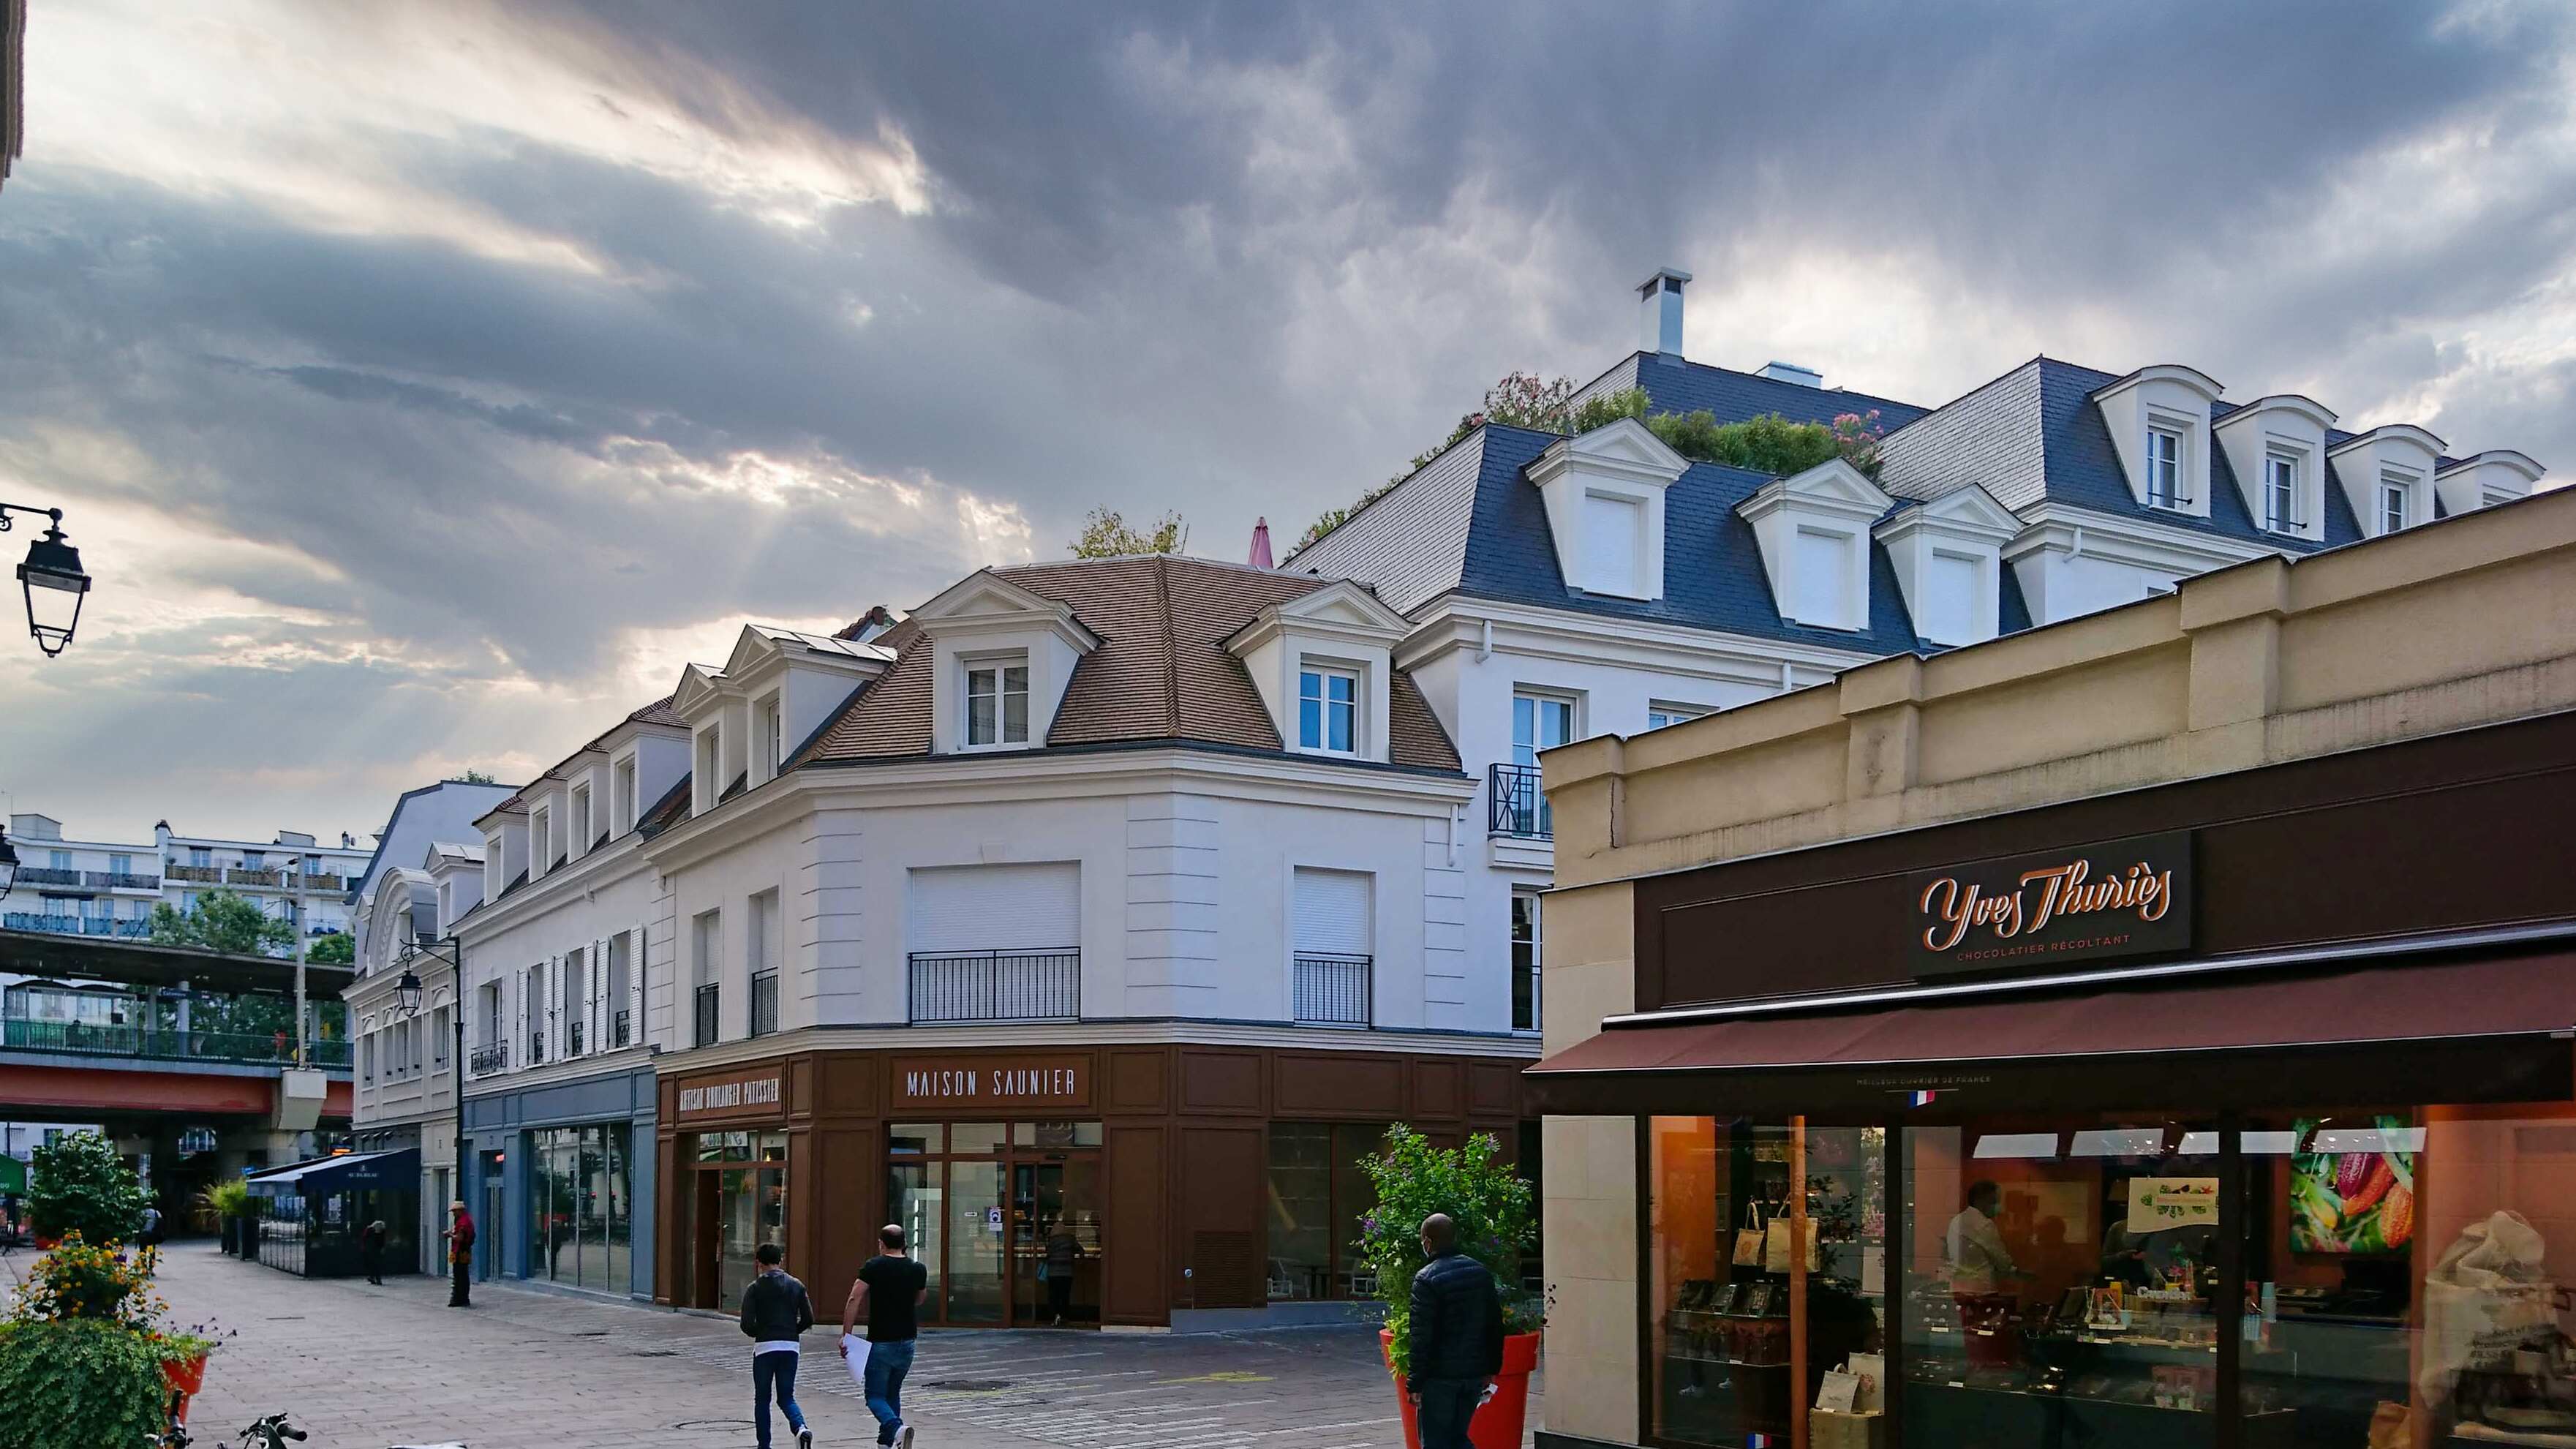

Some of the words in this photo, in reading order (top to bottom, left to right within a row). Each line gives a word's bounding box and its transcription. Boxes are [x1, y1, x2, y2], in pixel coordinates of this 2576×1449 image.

[1919, 877, 2022, 952] Yves
[2019, 858, 2172, 935] Thuriès
[1957, 944, 2046, 961] CHOCOLATIER
[907, 1070, 976, 1096] MAISON
[993, 1069, 1074, 1096] SAUNIER
